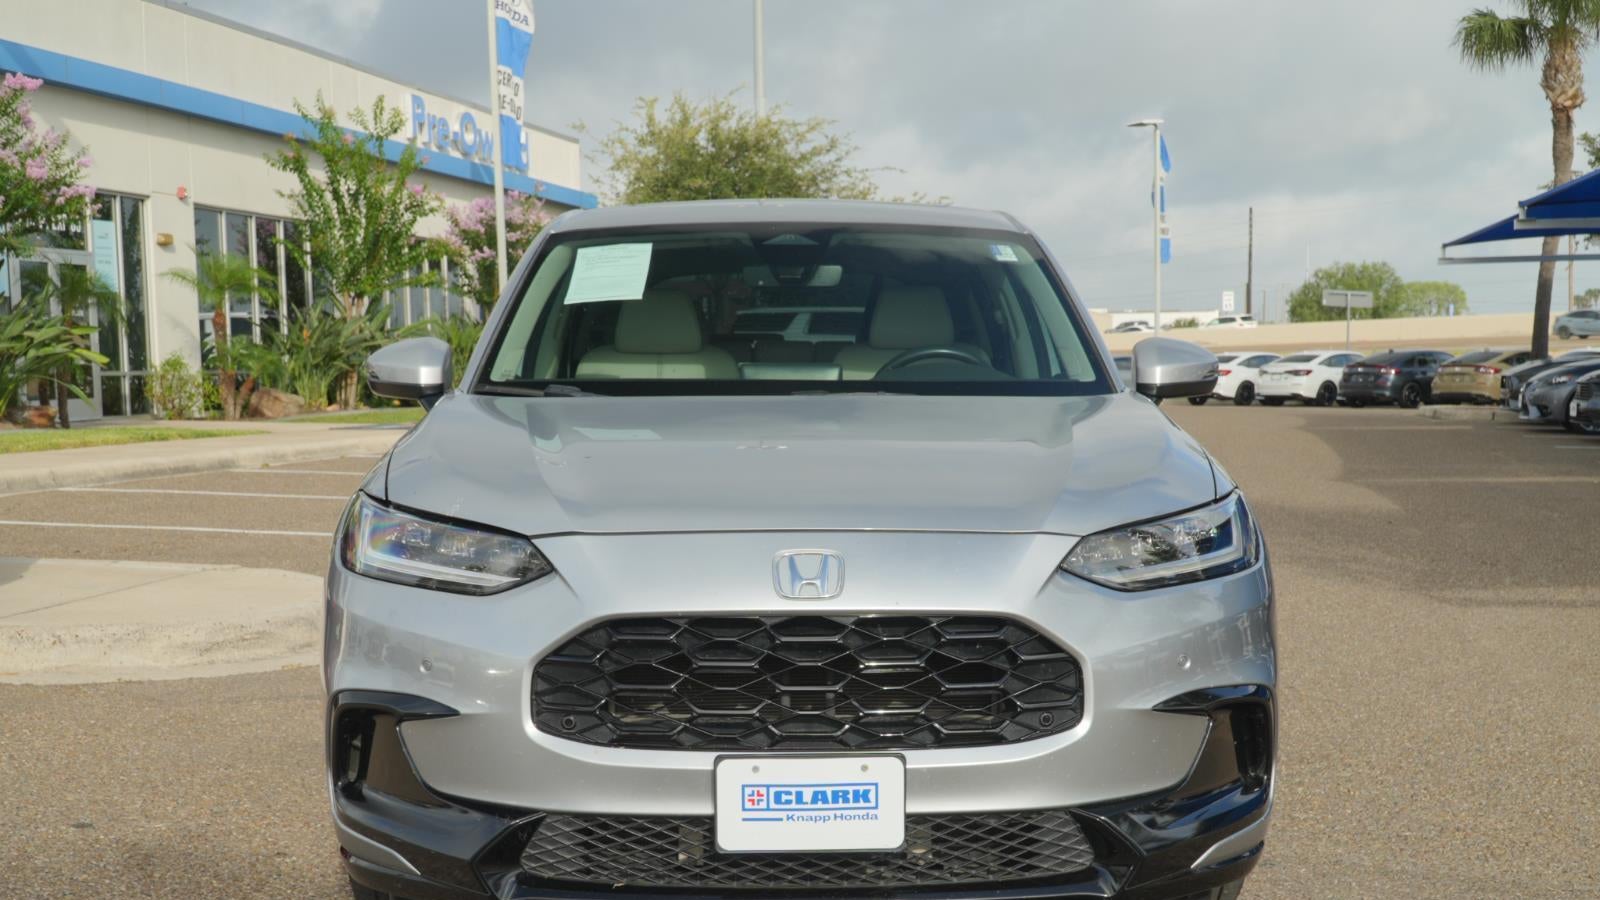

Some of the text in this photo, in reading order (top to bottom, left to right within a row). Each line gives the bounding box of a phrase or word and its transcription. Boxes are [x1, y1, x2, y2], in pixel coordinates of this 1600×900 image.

[773, 788, 872, 806] CLARK
[786, 811, 879, 824] Knapp Honda
